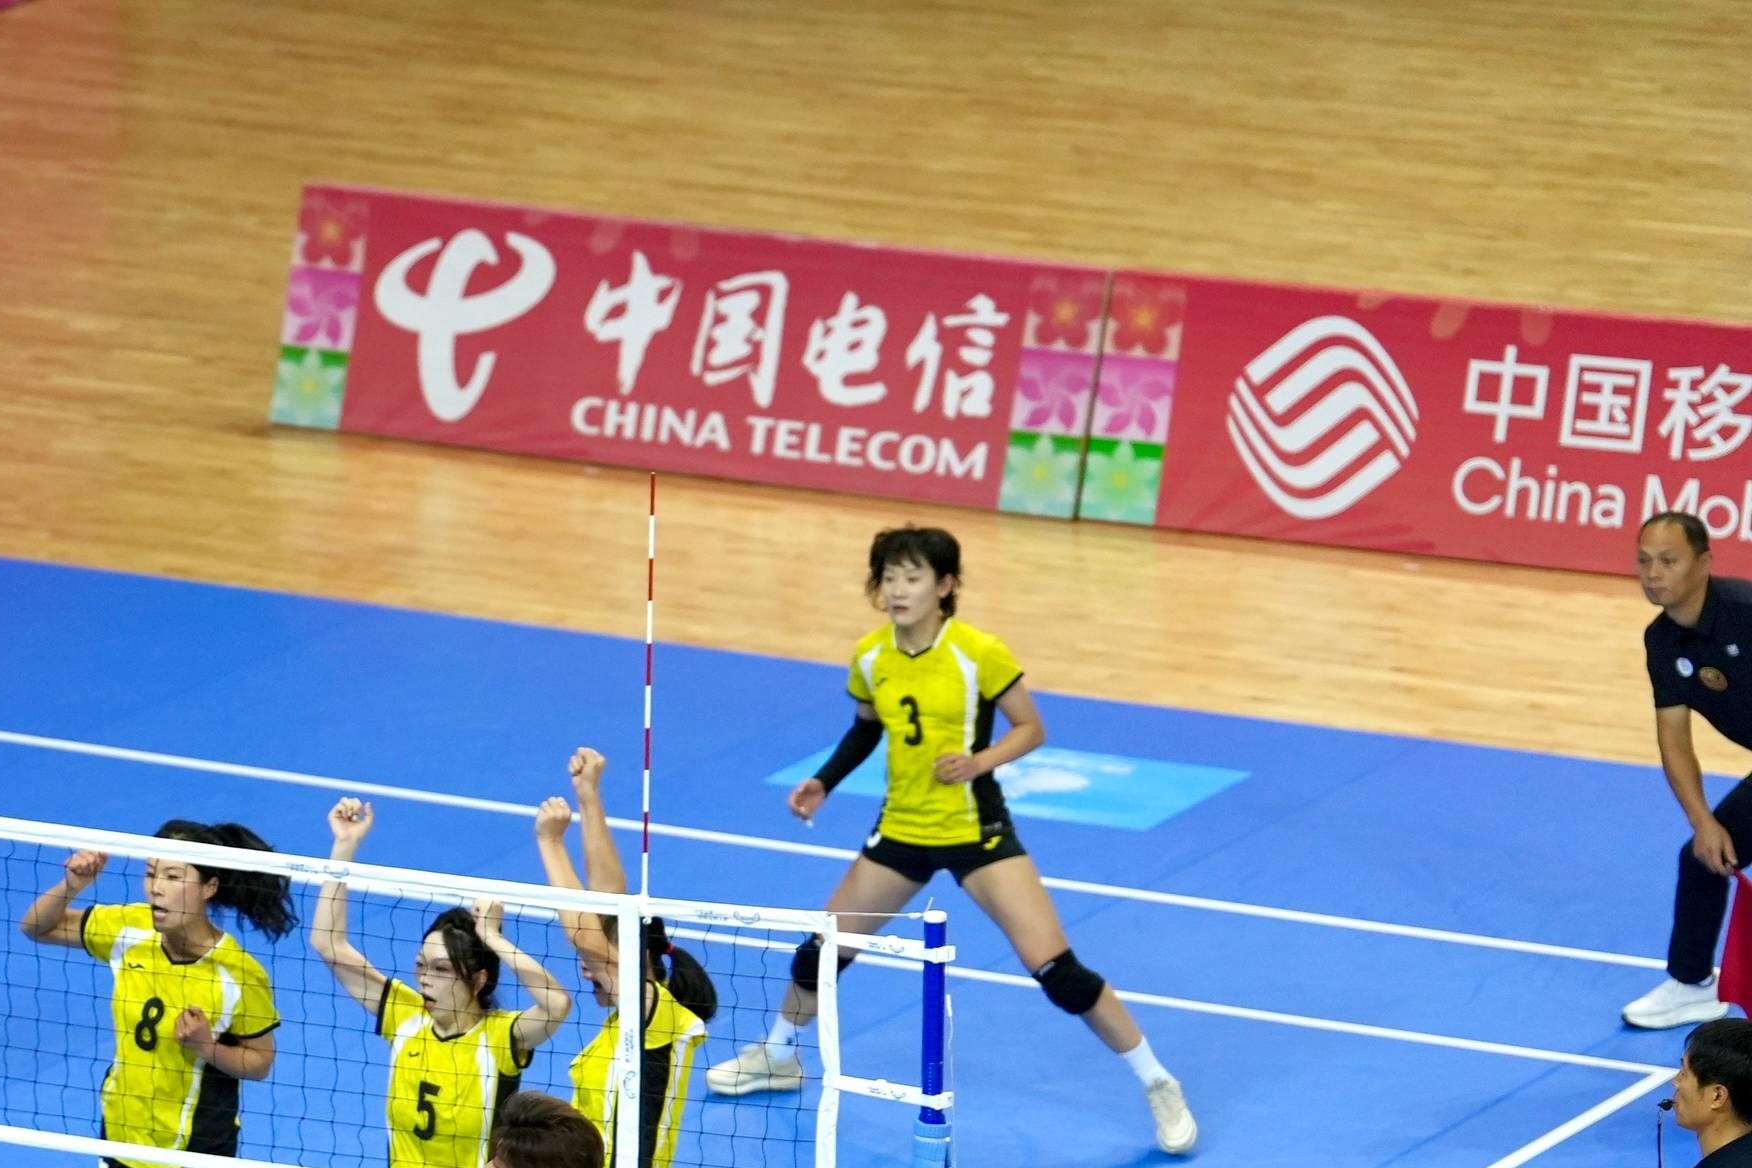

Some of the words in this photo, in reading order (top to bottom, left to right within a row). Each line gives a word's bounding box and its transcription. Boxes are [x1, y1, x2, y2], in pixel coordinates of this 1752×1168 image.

[584, 250, 1010, 419] 中国电信
[571, 396, 732, 451] CHINA
[746, 415, 989, 481] TELECOM
[1462, 344, 1752, 461] 中国移
[1452, 455, 1626, 529] China
[900, 695, 924, 746] 3
[135, 997, 165, 1051] 8
[412, 1081, 441, 1141] 5
